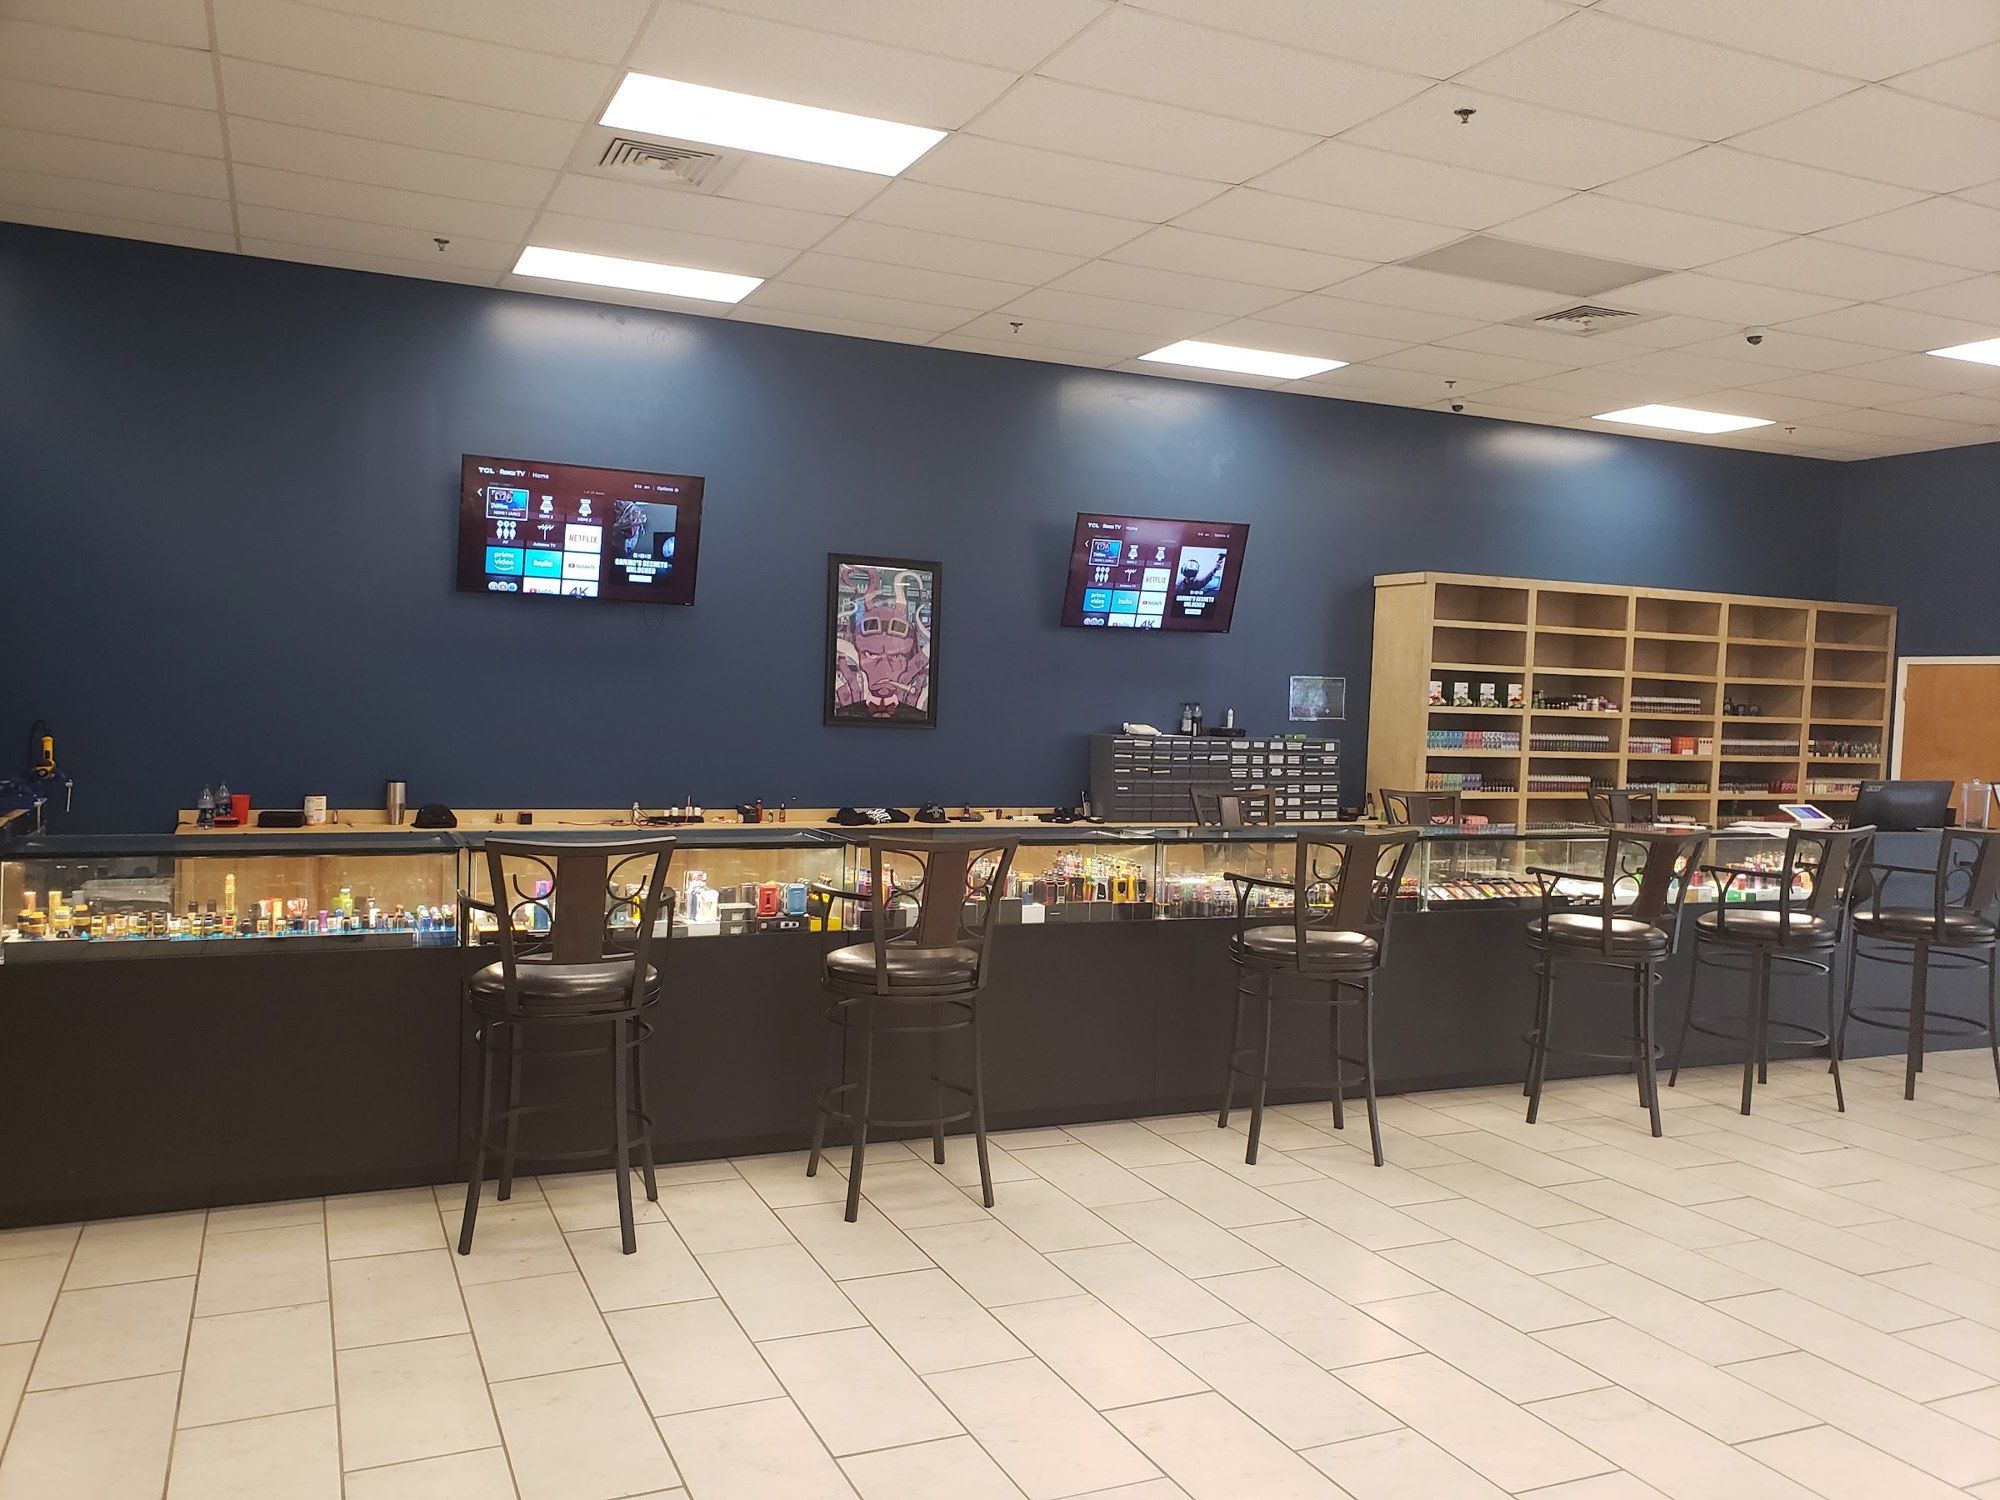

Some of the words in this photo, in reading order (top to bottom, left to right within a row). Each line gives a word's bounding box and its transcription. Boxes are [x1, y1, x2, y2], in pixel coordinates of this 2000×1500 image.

[478, 466, 495, 474] TCL
[532, 472, 549, 480] Home
[568, 534, 598, 544] NETFLIX
[493, 551, 515, 560] prime
[494, 558, 515, 566] video
[532, 559, 554, 567] hulu
[1145, 576, 1167, 584] NETFLIX
[569, 586, 589, 597] 4K
